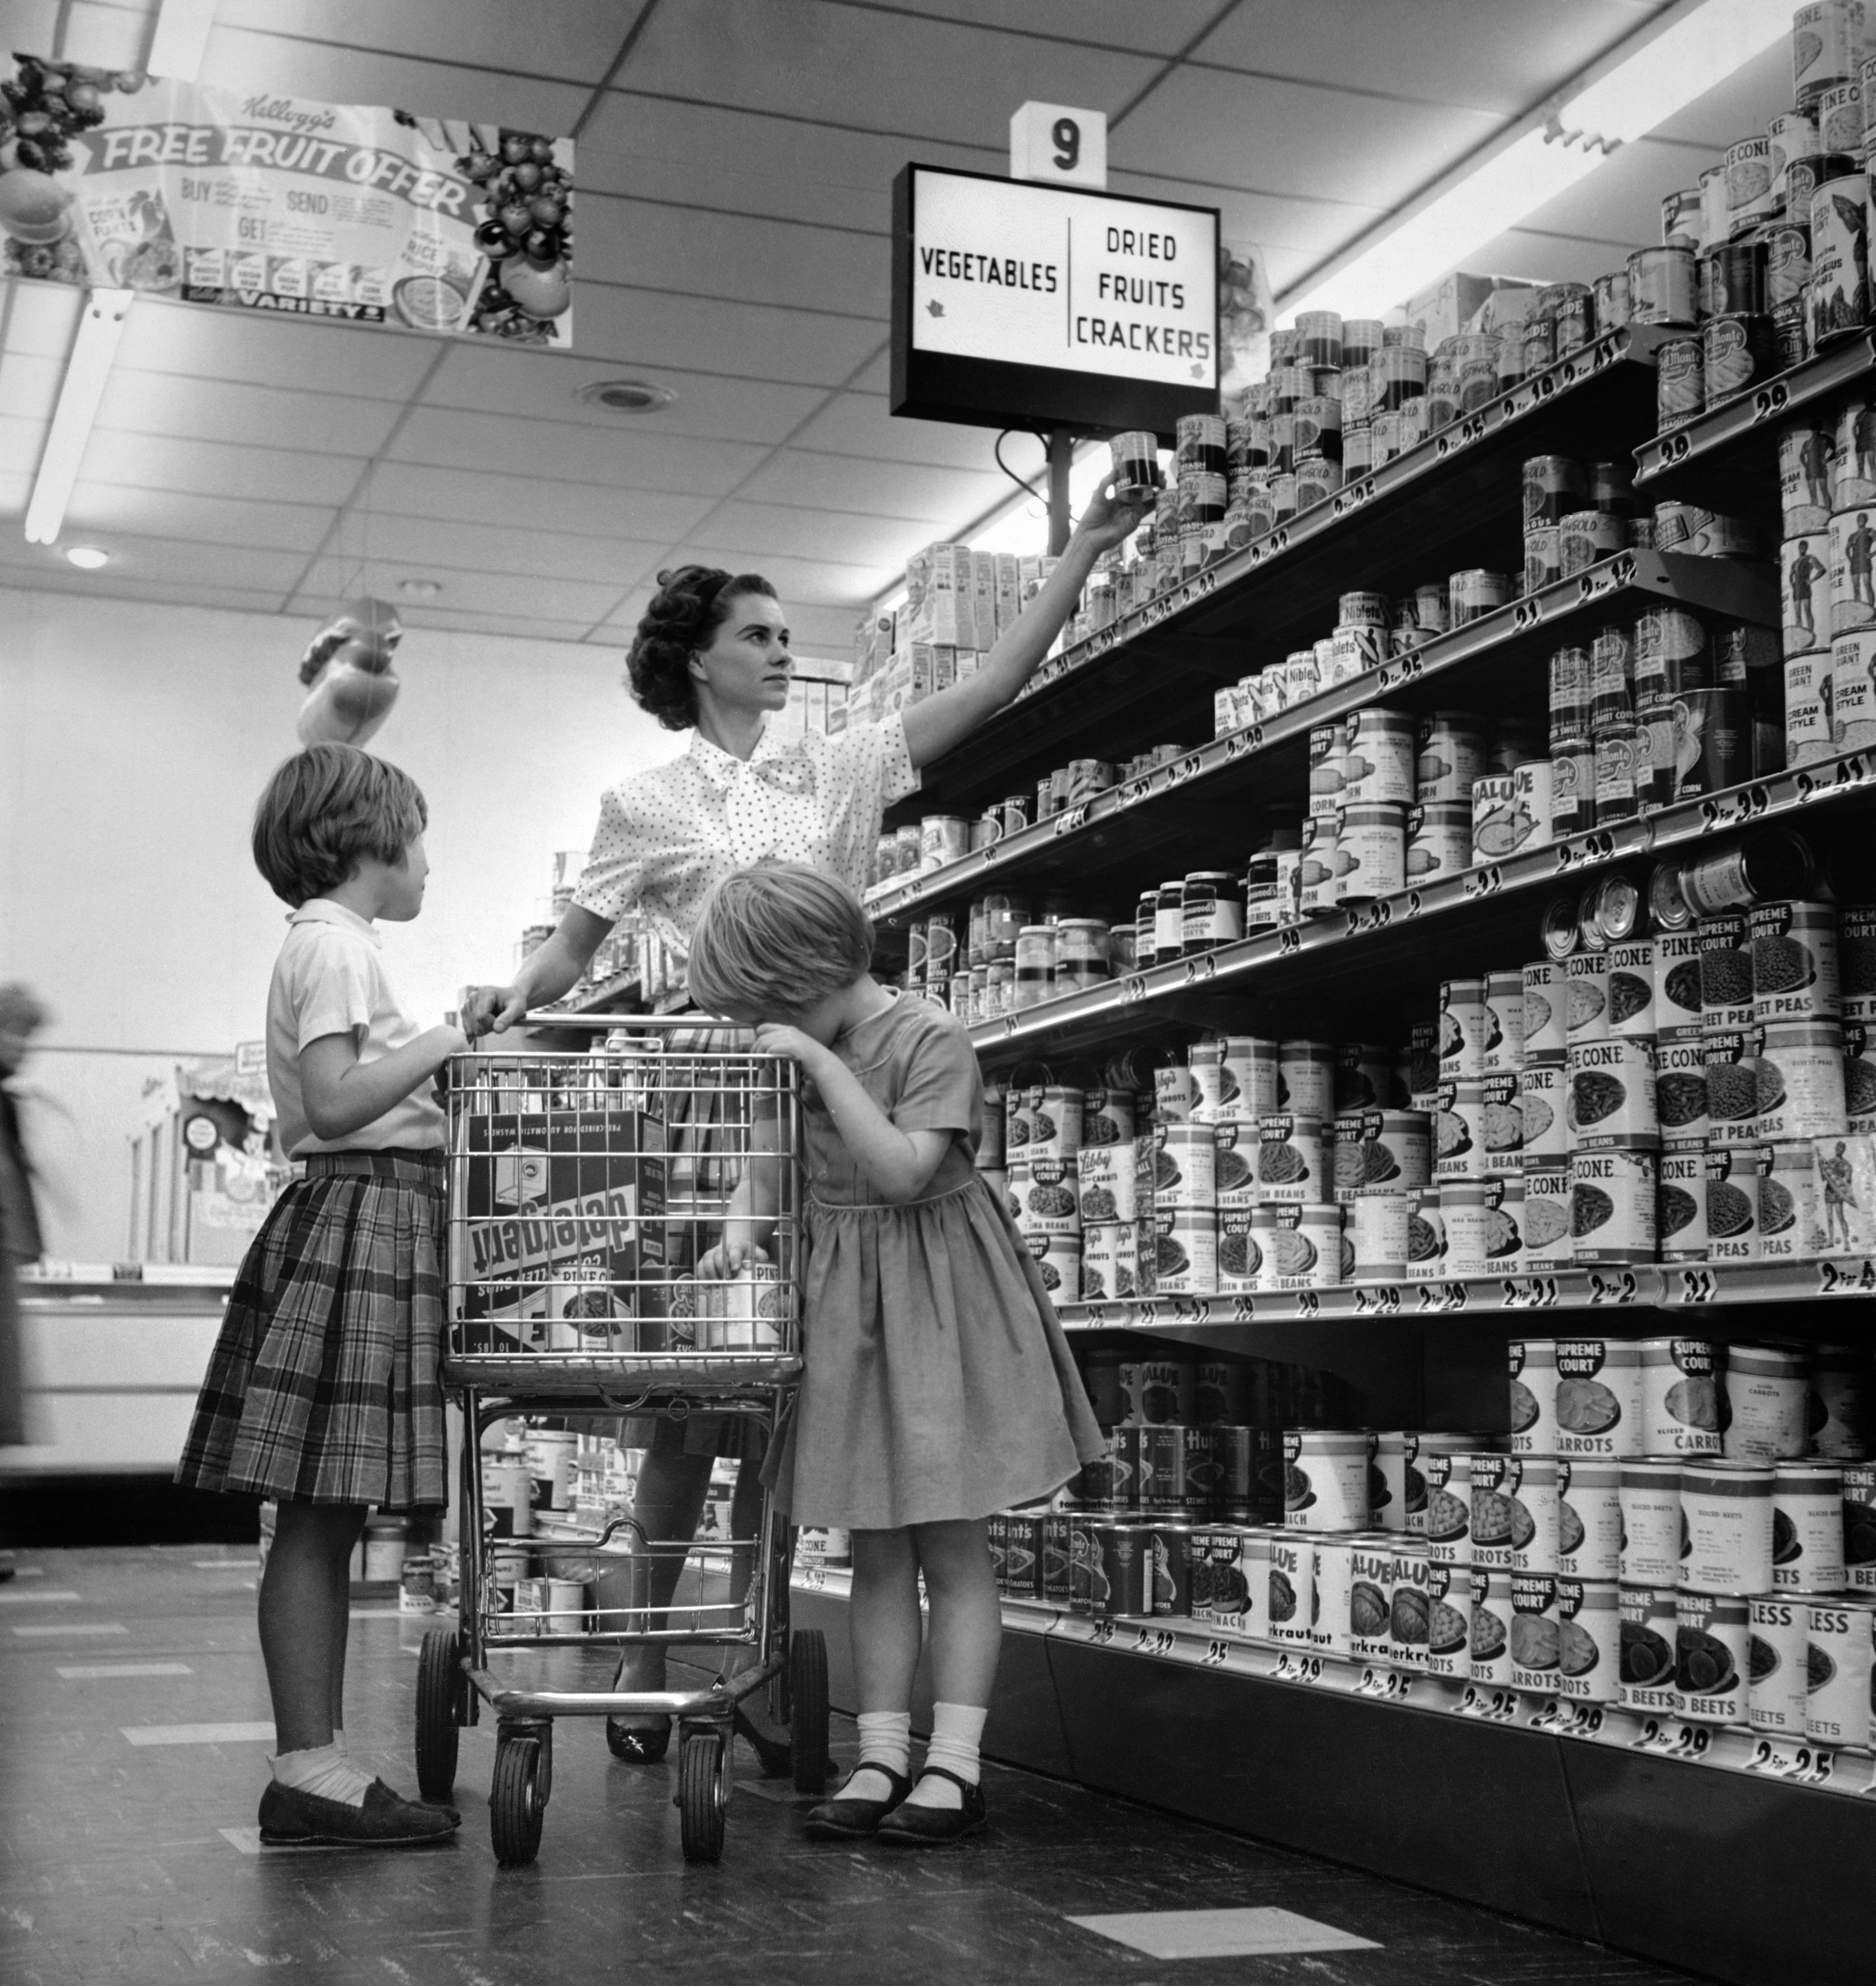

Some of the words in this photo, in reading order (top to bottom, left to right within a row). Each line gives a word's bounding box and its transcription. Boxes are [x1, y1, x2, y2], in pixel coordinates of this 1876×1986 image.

[242, 93, 336, 133] Kellogg's
[1052, 117, 1080, 170] 9
[103, 126, 214, 168] FREE
[220, 129, 348, 174] FRUIT
[345, 148, 466, 216] OFFER
[182, 177, 212, 202] BUY
[287, 191, 328, 214] SEND
[238, 217, 267, 241] GET
[1107, 226, 1176, 261] DRIED
[921, 246, 1057, 293] VEGETABLES
[1099, 273, 1185, 310] FRUITS
[238, 290, 362, 319] VARIETY
[1076, 316, 1210, 360] CRACKERS
[1836, 642, 1860, 658] GREEN
[1788, 664, 1812, 680] GREEN
[1835, 684, 1867, 701] CREAM
[1836, 695, 1865, 711] STYLE
[1788, 705, 1819, 722] CREAM
[1788, 717, 1817, 731] STYLE
[1798, 773, 1814, 804] 2
[1312, 799, 1336, 812] CORN
[1701, 802, 1718, 834] 2
[1557, 845, 1572, 872] 2
[1698, 921, 1741, 937] SUPREME
[1751, 922, 1782, 938] COURT
[1662, 936, 1698, 957] PINE
[1701, 936, 1734, 951] COURT
[1570, 956, 1606, 976] CONE
[1614, 947, 1652, 968] CONE
[1775, 997, 1814, 1013] PEAS
[1583, 1046, 1624, 1067] CONE
[563, 1125, 577, 1134] FOR
[1261, 1128, 1286, 1140] COURT
[1589, 1137, 1615, 1148] BEANS
[1678, 1139, 1705, 1149] BEANS
[1033, 1162, 1065, 1172] SUPREME
[1036, 1172, 1061, 1181] COURT
[1577, 1159, 1615, 1179] CONE
[1662, 1159, 1697, 1180] CONE
[1222, 1195, 1249, 1204] BEANS
[1272, 1190, 1306, 1200] BEANS
[471, 1192, 631, 1273] detergent
[1044, 1222, 1070, 1231] BEANS
[1578, 1250, 1599, 1261] BEANS
[1717, 1242, 1750, 1257] PEAS
[1764, 1240, 1792, 1255] PEAS
[1408, 1268, 1434, 1278] BEANS
[1531, 1262, 1555, 1271] BEANS
[1159, 1280, 1186, 1291] BEANS
[1280, 1278, 1312, 1289] BEANS
[1821, 1262, 1838, 1293] 2
[1419, 1285, 1433, 1311] 2
[1504, 1280, 1517, 1306] 2
[1590, 1275, 1606, 1303] 2
[1356, 1290, 1366, 1313] 2
[499, 1343, 510, 1353] 10
[1559, 1358, 1594, 1372] COURT
[1748, 1389, 1780, 1398] CARROTS
[1513, 1594, 1545, 1608] COURT
[1203, 1641, 1227, 1664] 25
[1271, 1653, 1288, 1675] 2
[1352, 1670, 1374, 1692] 2
[1460, 1687, 1476, 1710] 2
[1488, 1692, 1517, 1719] 25
[1632, 1688, 1674, 1707] BEETS
[1691, 1697, 1737, 1716] BEETS
[1531, 1701, 1558, 1726] 2
[1633, 1720, 1659, 1747] 2
[1744, 1741, 1771, 1770] 2
[1771, 1754, 1789, 1770] For
[1783, 1748, 1832, 1784] 25
